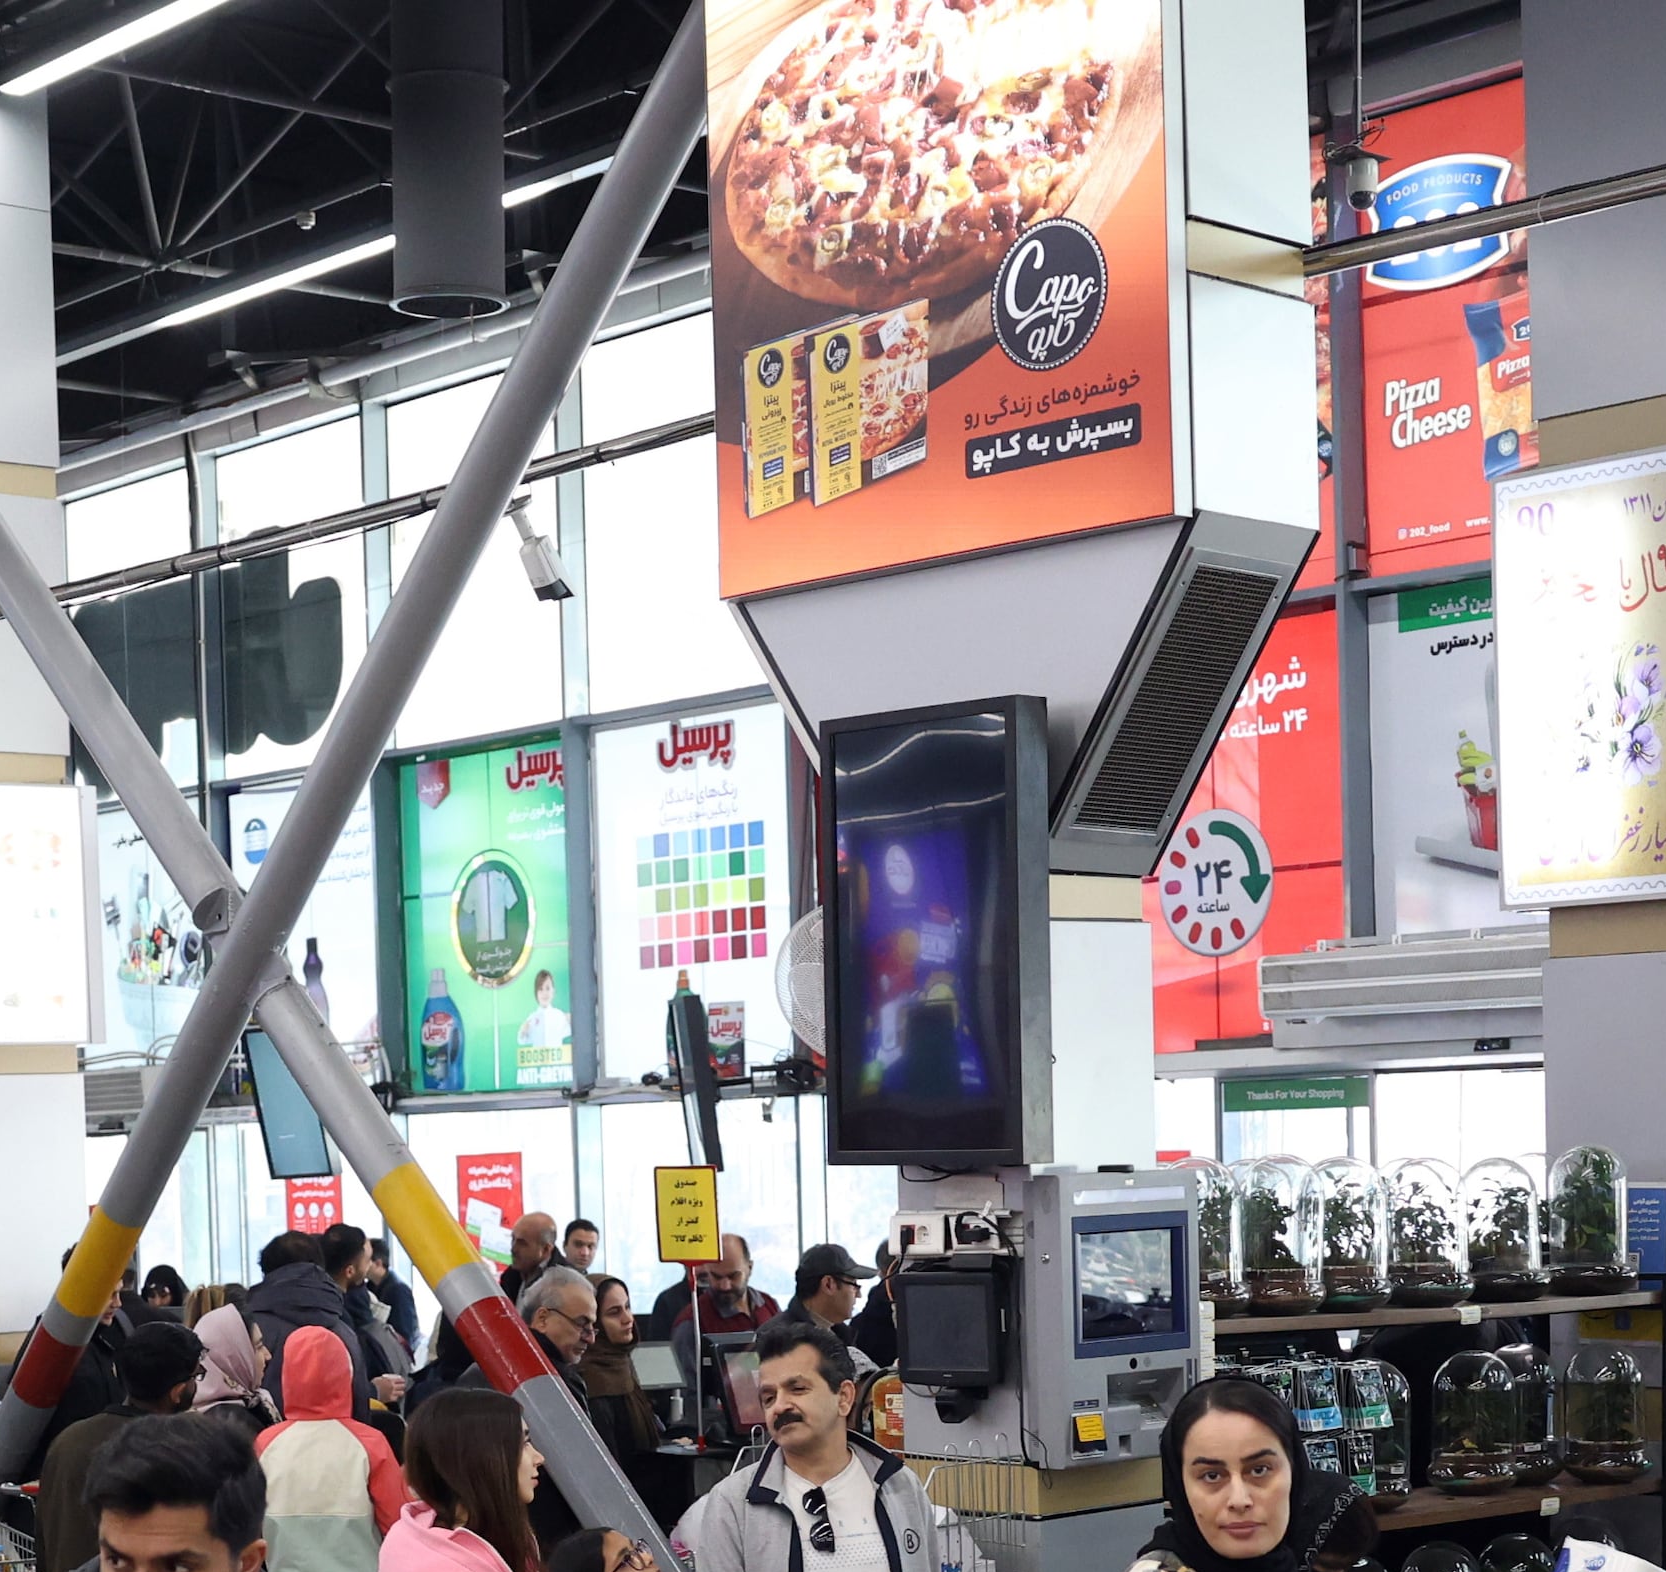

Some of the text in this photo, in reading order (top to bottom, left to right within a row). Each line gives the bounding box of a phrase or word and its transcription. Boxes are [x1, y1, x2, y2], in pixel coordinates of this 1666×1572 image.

[1386, 171, 1483, 205] FOOD PRODUCTS
[1005, 238, 1099, 320] Capo
[1497, 354, 1531, 379] Pizza
[1384, 376, 1440, 417] Pizza
[964, 412, 980, 430] رو
[984, 394, 1032, 426] زندگی
[1391, 404, 1472, 450] Cheese
[972, 416, 1134, 473] بسپرش به کاپو
[1409, 521, 1451, 539] 202_food
[1429, 594, 1493, 617] رین کیفیت
[1430, 633, 1478, 656] دسترس
[1233, 655, 1307, 708] شهرو
[1230, 707, 1309, 740] ۲۴ ساعته
[658, 722, 732, 768] پرسیل
[421, 782, 445, 794] جدید
[1194, 858, 1232, 896] ۲۴
[1196, 898, 1230, 914] ساعته
[711, 1019, 742, 1039] پرسیل
[520, 1047, 563, 1064] BOOSTED
[517, 1065, 573, 1085] ANTI-GREYIN
[674, 1180, 697, 1189] صندوق
[688, 1198, 703, 1207] ویژه
[686, 1215, 699, 1227] کمتر
